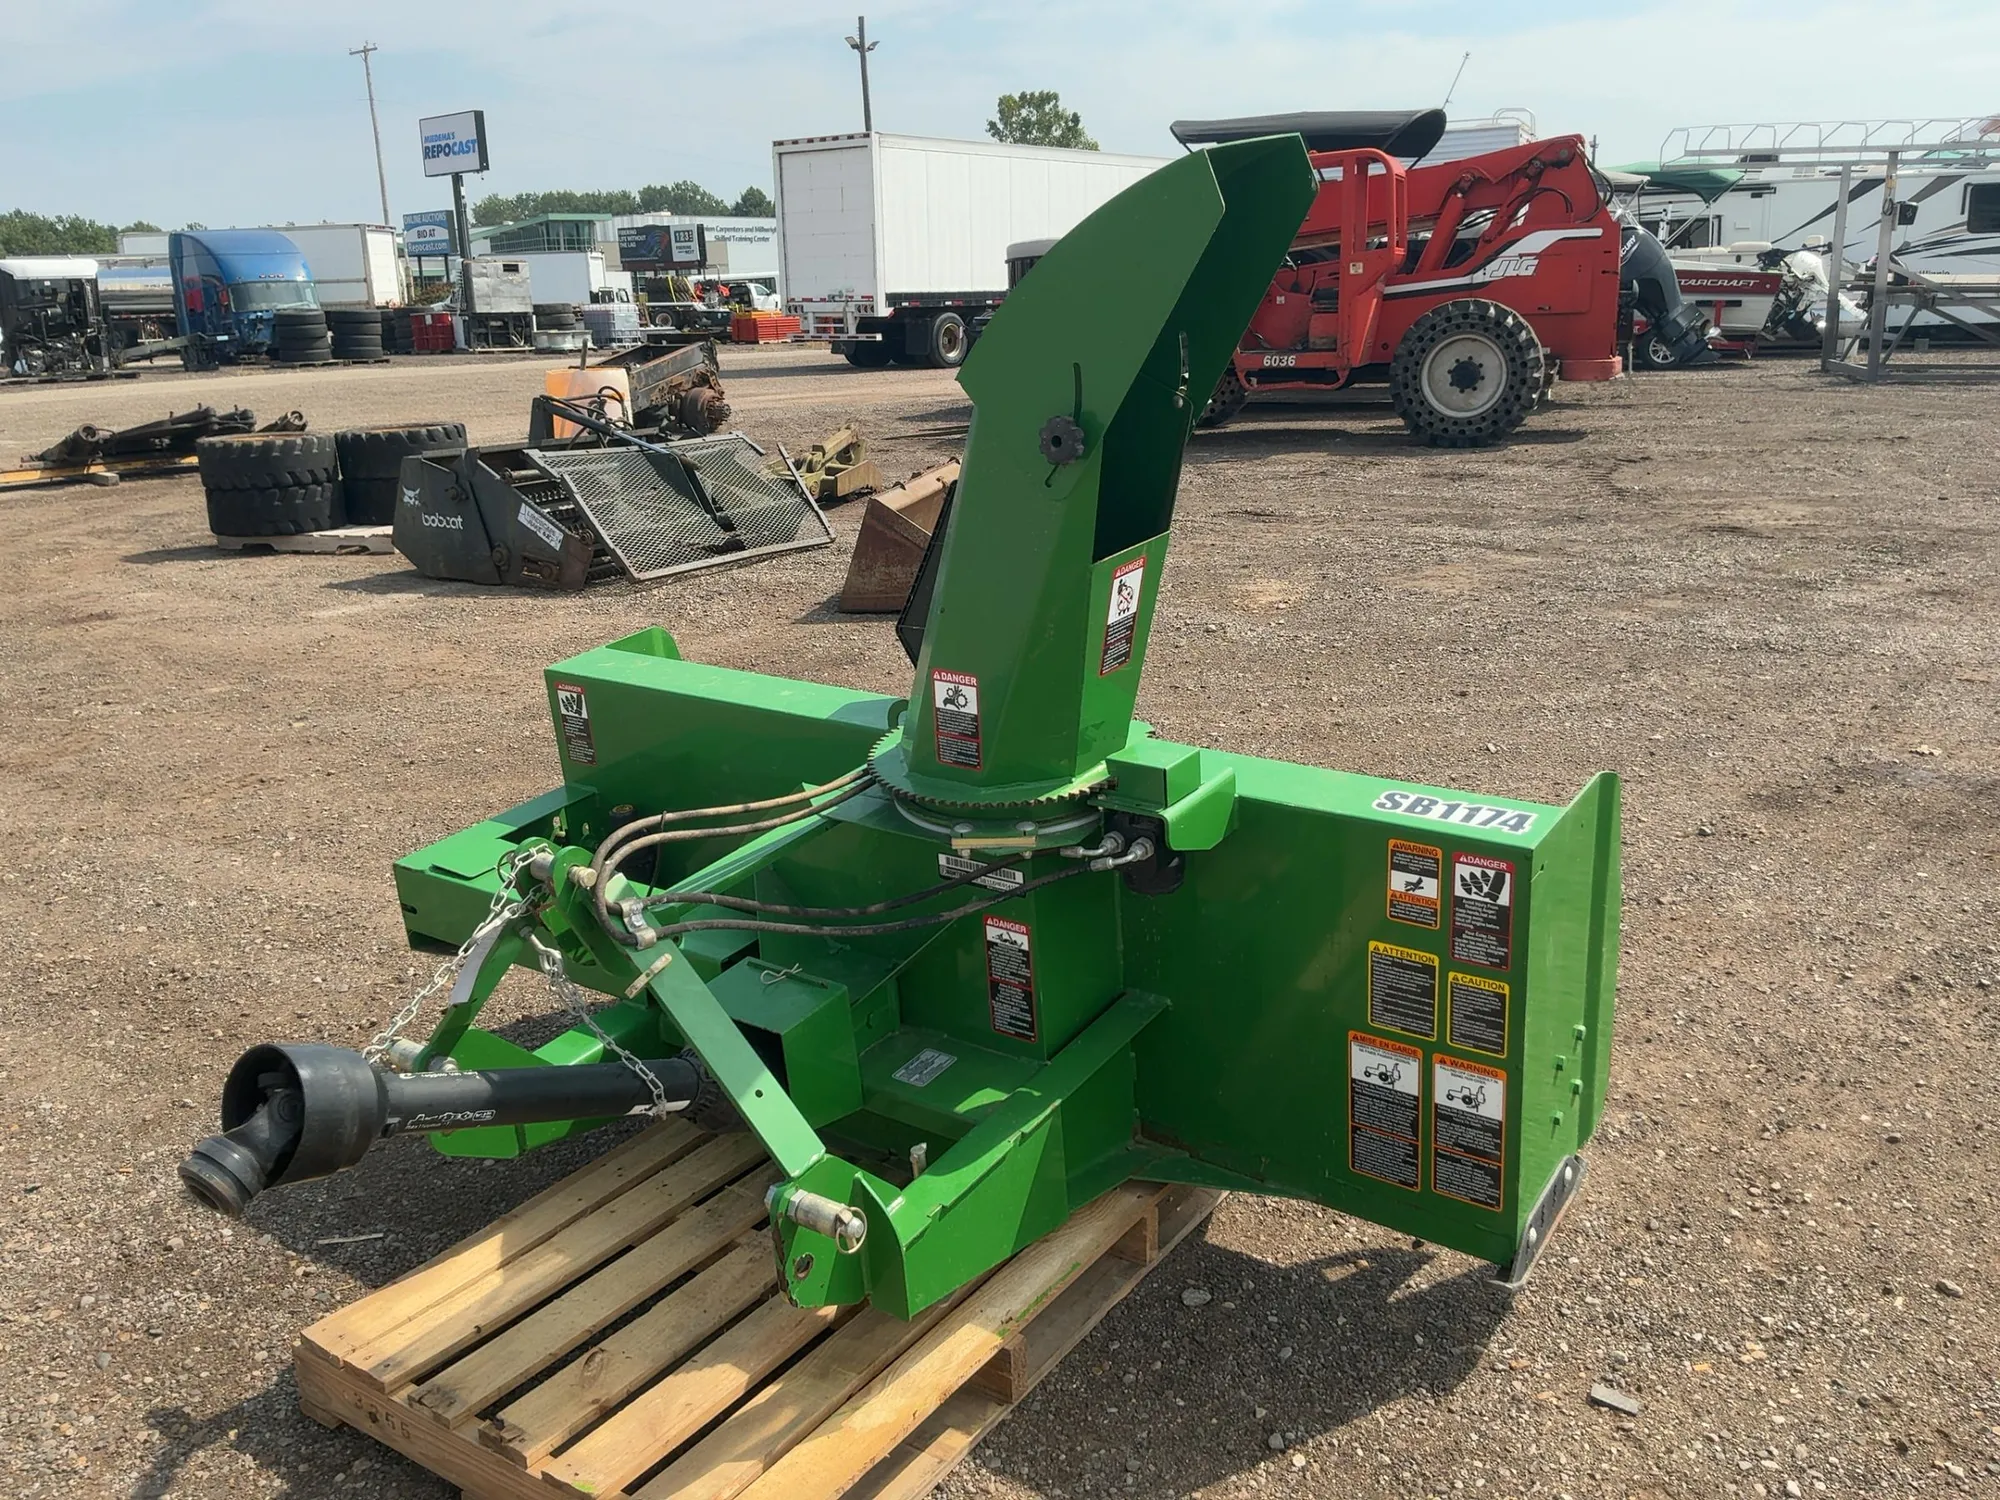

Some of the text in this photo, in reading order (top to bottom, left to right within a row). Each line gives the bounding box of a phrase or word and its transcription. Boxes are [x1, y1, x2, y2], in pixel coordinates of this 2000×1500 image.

[424, 139, 477, 160] REPOCAST
[422, 212, 446, 222] AUCTIONS
[417, 229, 436, 239] BID AT
[732, 236, 753, 244] Training
[408, 242, 448, 252] Repocast.com
[1490, 259, 1539, 278] JLG
[1264, 355, 1296, 367] 6036
[422, 512, 464, 530] bobcat
[1120, 558, 1144, 574] DANGER
[941, 672, 977, 686] DANGER
[562, 684, 582, 692] DANGER
[1375, 792, 1534, 833] SB1174
[1399, 842, 1438, 857] WARNING
[1466, 856, 1507, 870] DANGER
[1397, 894, 1438, 907] ATTENTION
[994, 918, 1027, 933] DANGER
[1382, 946, 1435, 964] ATTENTION
[1461, 976, 1505, 991] CAUTION
[1360, 1036, 1375, 1044] MISE
[1391, 1044, 1418, 1056] GARDE
[1450, 1059, 1498, 1078] WARNING
